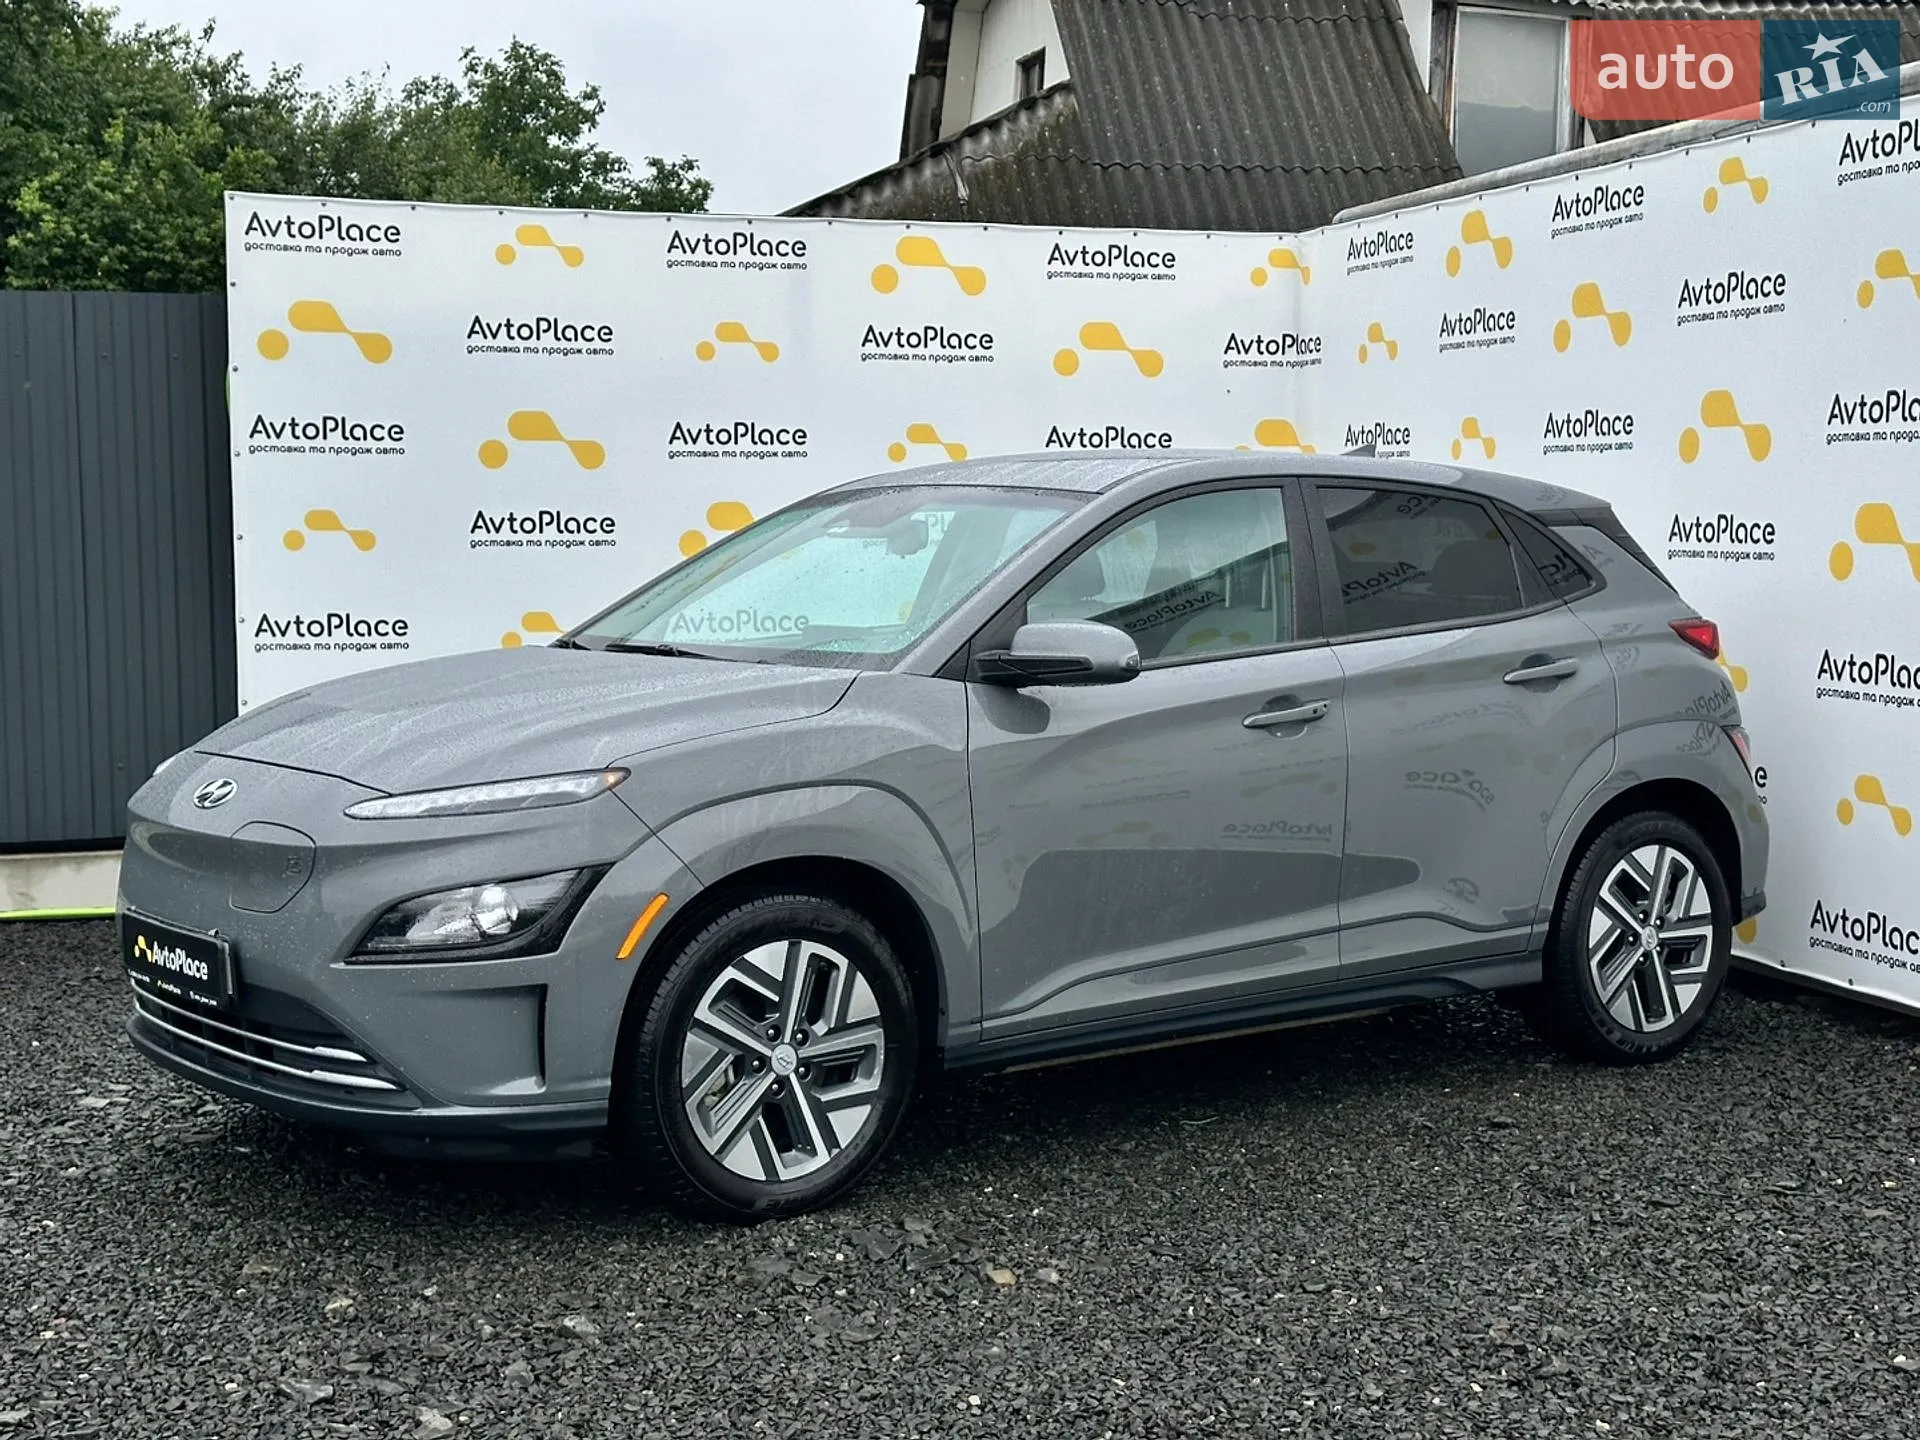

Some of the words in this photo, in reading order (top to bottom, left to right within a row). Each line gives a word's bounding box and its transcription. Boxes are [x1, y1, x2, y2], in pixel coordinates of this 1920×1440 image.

[1837, 166, 1883, 187] доставка
[1885, 163, 1900, 175] та
[1552, 184, 1644, 223] AvtoPlace
[244, 211, 401, 244] AvtoPlace
[244, 241, 303, 253] доставка
[304, 245, 323, 254] та
[324, 246, 369, 257] продаж
[371, 248, 402, 257] авто
[667, 230, 807, 258] AvtoPlace
[1047, 242, 1176, 269] AvtoPlace
[1347, 230, 1414, 262] AvtoPlace
[666, 259, 719, 269] доставка
[720, 261, 737, 269] та
[738, 261, 778, 272] продаж
[780, 262, 808, 271] авто
[1046, 270, 1095, 280] доставка
[1096, 272, 1111, 280] та
[1112, 272, 1149, 282] продаж
[1150, 273, 1176, 281] авто
[1677, 270, 1786, 309] AvtoPlace
[467, 315, 613, 343] AvtoPlace
[1439, 307, 1516, 338] AvtoPlace
[861, 324, 994, 350] AvtoPlace
[1223, 332, 1322, 356] AvtoPlace
[466, 344, 521, 355] доставка
[522, 346, 540, 354] та
[541, 346, 584, 357] продаж
[585, 347, 615, 356] авто
[860, 352, 910, 362] доставка
[911, 353, 927, 361] та
[928, 353, 967, 364] продаж
[967, 354, 995, 363] авто
[249, 414, 405, 442] AvtoPlace
[668, 421, 807, 446] AvtoPlace
[1344, 422, 1410, 446] AvtoPlace
[1544, 409, 1634, 439] AvtoPlace
[1045, 425, 1172, 449] AvtoPlace
[1825, 431, 1871, 446] доставка
[1872, 431, 1888, 441] та
[248, 444, 306, 455] доставка
[308, 446, 326, 454] та
[328, 446, 373, 457] продаж
[374, 447, 406, 455] авто
[667, 450, 720, 460] доставка
[721, 450, 738, 458] та
[739, 450, 779, 460] продаж
[781, 450, 808, 458] авто
[470, 510, 616, 535] AvtoPlace
[1668, 513, 1776, 545] AvtoPlace
[469, 539, 524, 549] доставка
[525, 539, 543, 547] та
[544, 539, 586, 549] продаж
[587, 539, 617, 547] авто
[1667, 549, 1705, 560] доставка
[1706, 550, 1719, 559] та
[1719, 550, 1751, 563] продаж
[1752, 551, 1776, 561] авто
[254, 612, 409, 638] AvtoPlace
[671, 610, 809, 634] AvtoPlace
[254, 642, 312, 654] доставка
[313, 642, 331, 651] та
[333, 642, 378, 653] продаж
[379, 642, 410, 650] авто
[1816, 687, 1861, 701] доставка
[1862, 692, 1877, 703] та
[1878, 694, 1915, 709] продаж
[152, 941, 208, 980] AvtoPlace
[1808, 936, 1854, 957] доставка
[1854, 948, 1869, 960] та
[1870, 952, 1908, 970] продаж
